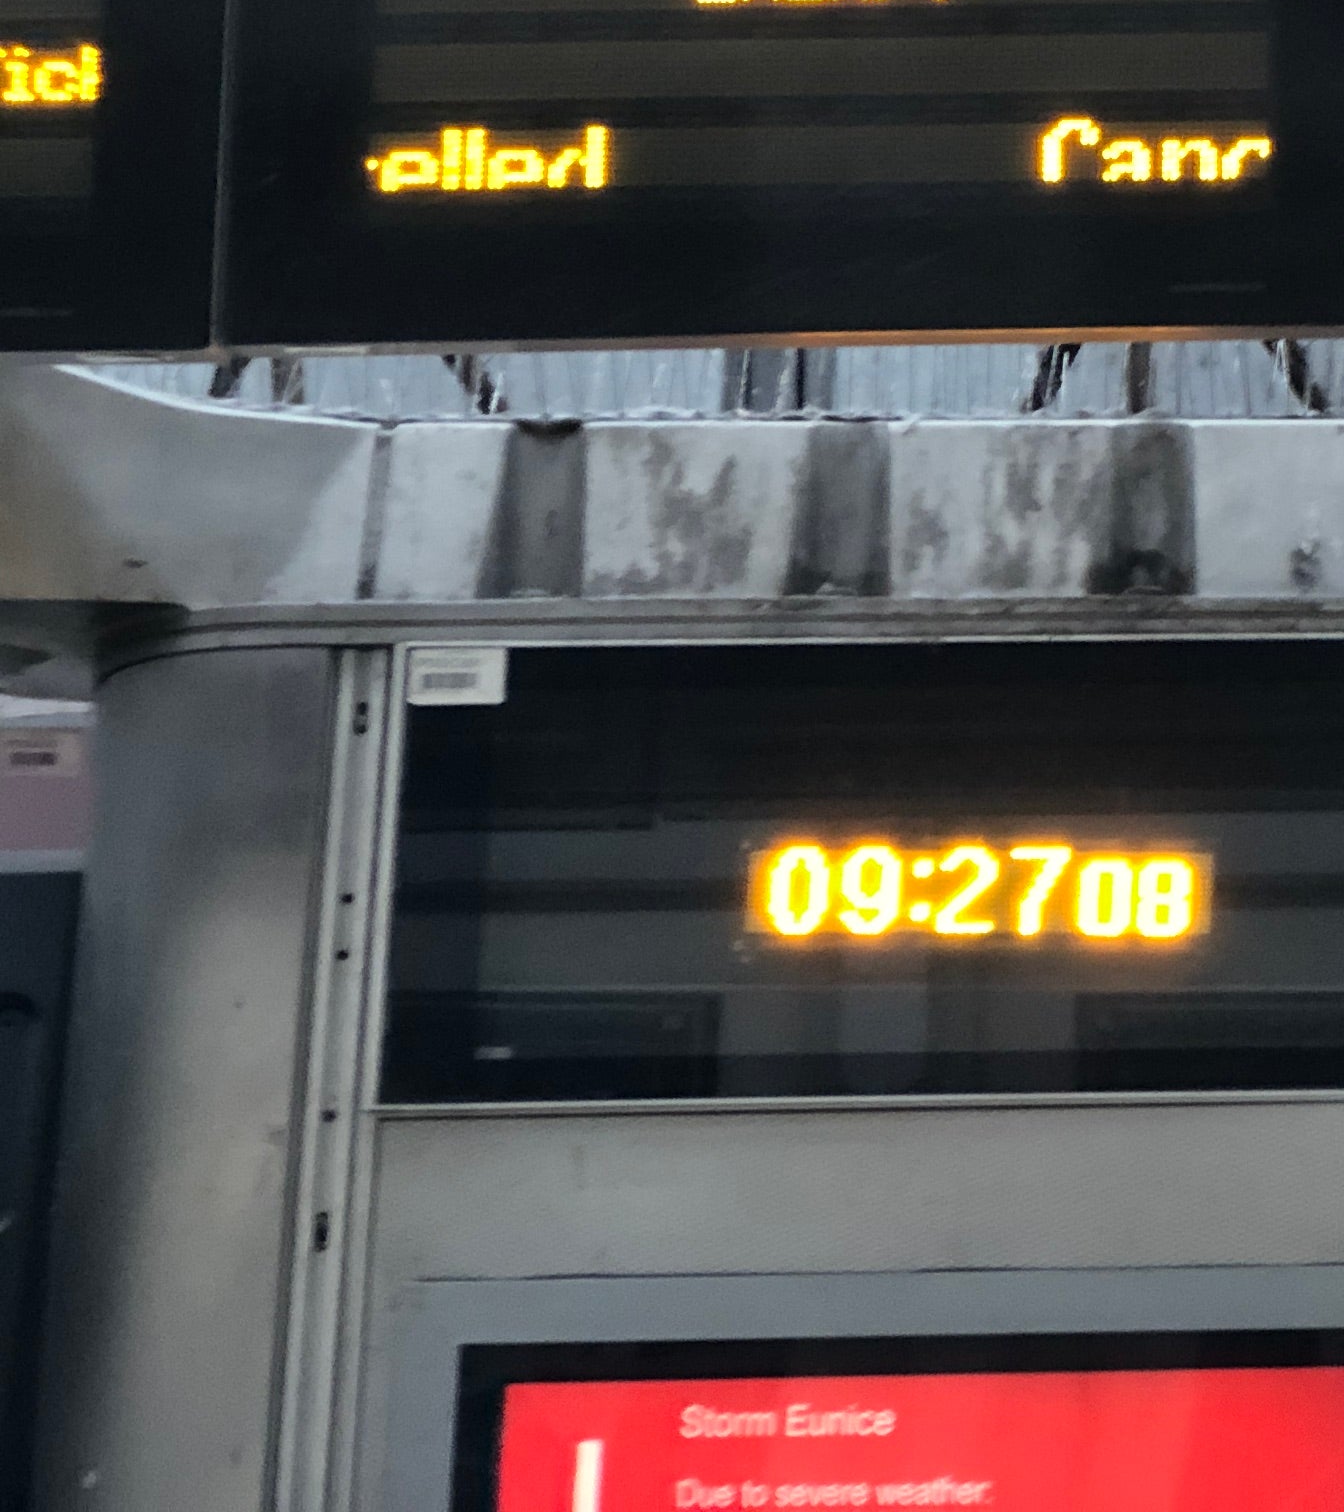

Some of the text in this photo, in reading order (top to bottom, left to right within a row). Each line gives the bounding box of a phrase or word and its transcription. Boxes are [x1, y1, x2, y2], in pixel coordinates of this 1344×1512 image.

[0, 43, 103, 106] ic
[364, 123, 611, 193] elled
[765, 842, 1073, 938] 09:27
[680, 1404, 896, 1438] Storm Eunice
[675, 1479, 735, 1507] Due
[742, 1481, 768, 1506] to
